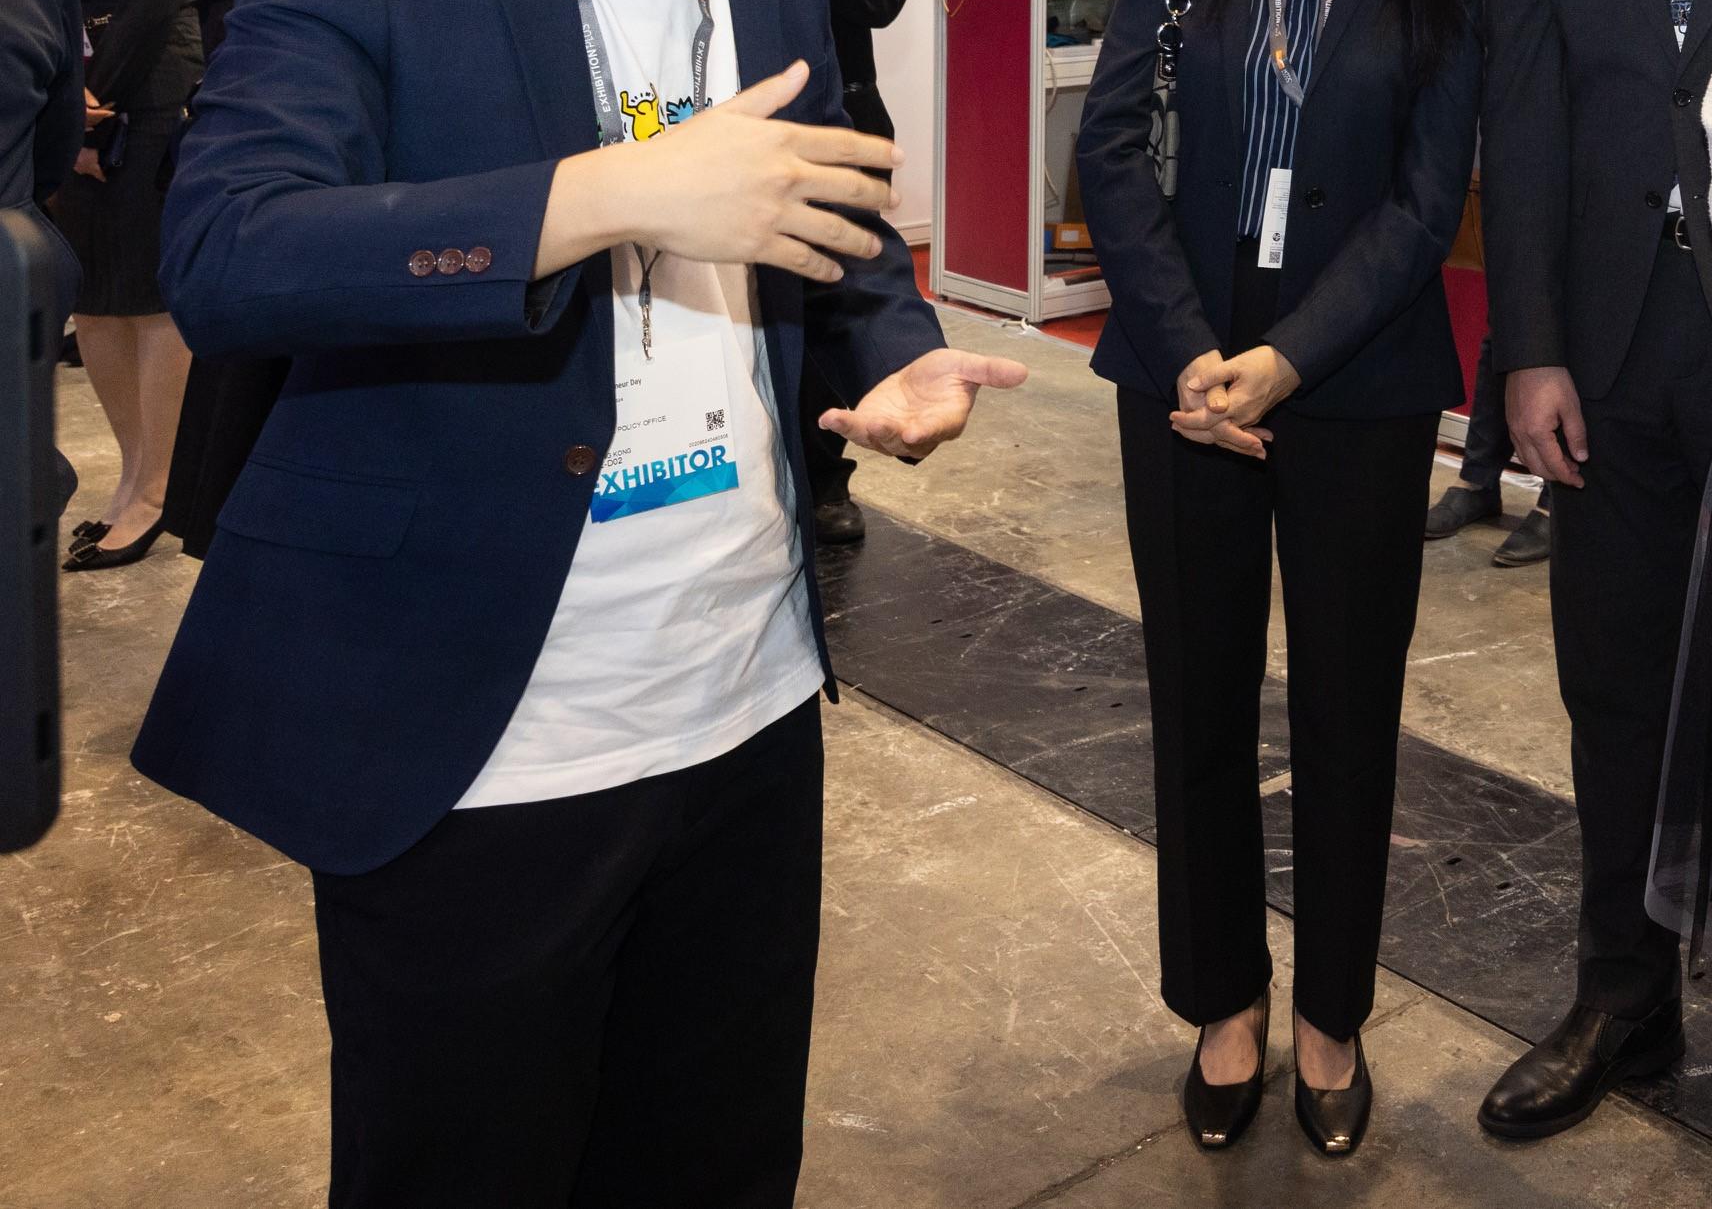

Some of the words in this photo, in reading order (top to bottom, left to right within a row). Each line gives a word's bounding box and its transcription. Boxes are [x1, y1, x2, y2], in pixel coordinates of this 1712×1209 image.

[630, 378, 642, 387] Day
[617, 422, 642, 432] POLICY
[643, 415, 667, 427] OFFICE
